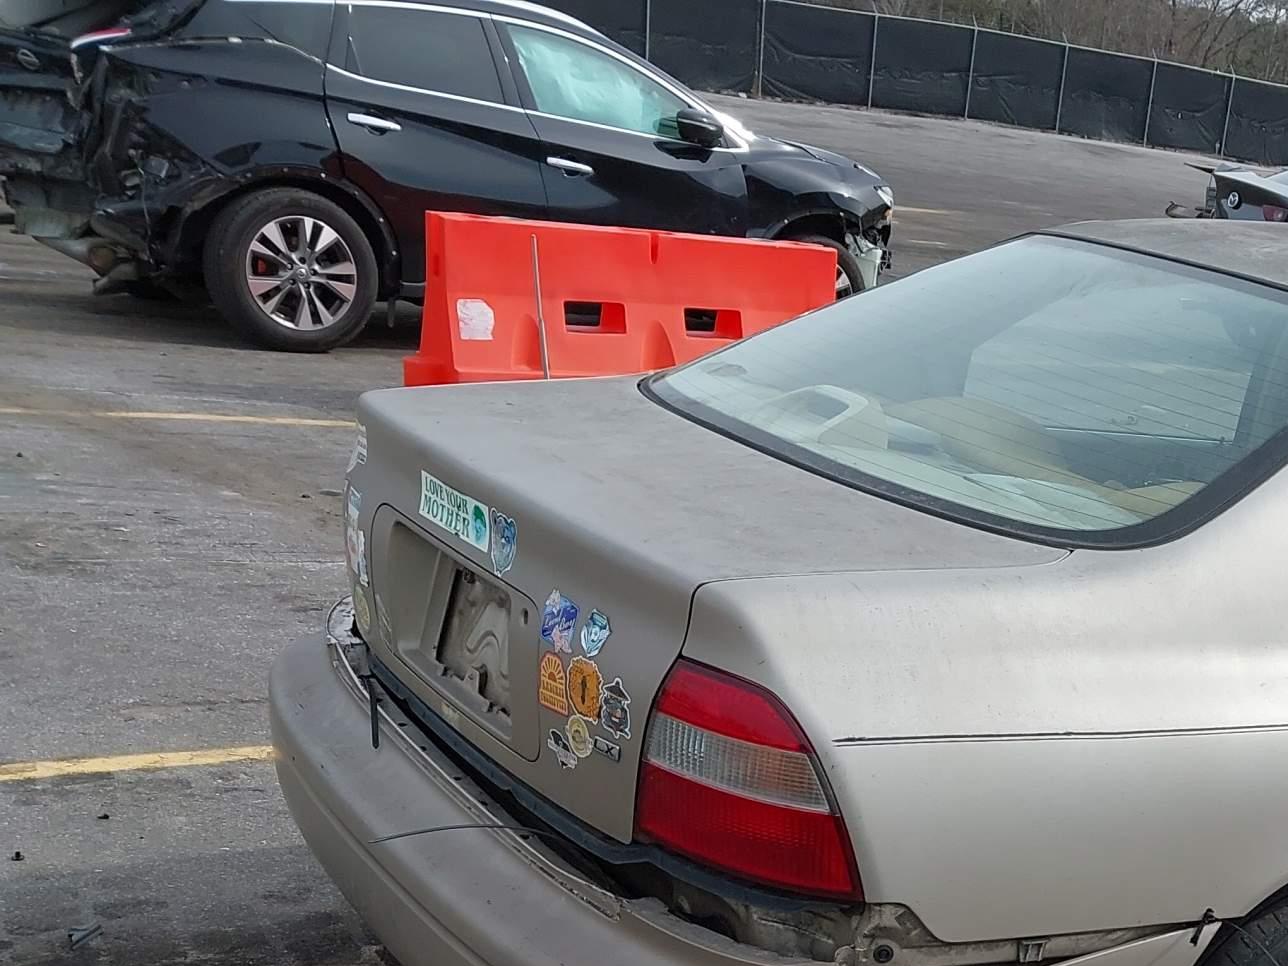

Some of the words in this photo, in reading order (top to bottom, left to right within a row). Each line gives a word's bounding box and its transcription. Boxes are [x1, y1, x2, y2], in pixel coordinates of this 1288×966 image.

[422, 493, 471, 539] MOTHER
[425, 476, 445, 501] LOVE
[444, 488, 469, 516] YOUR
[594, 738, 614, 757] LX
